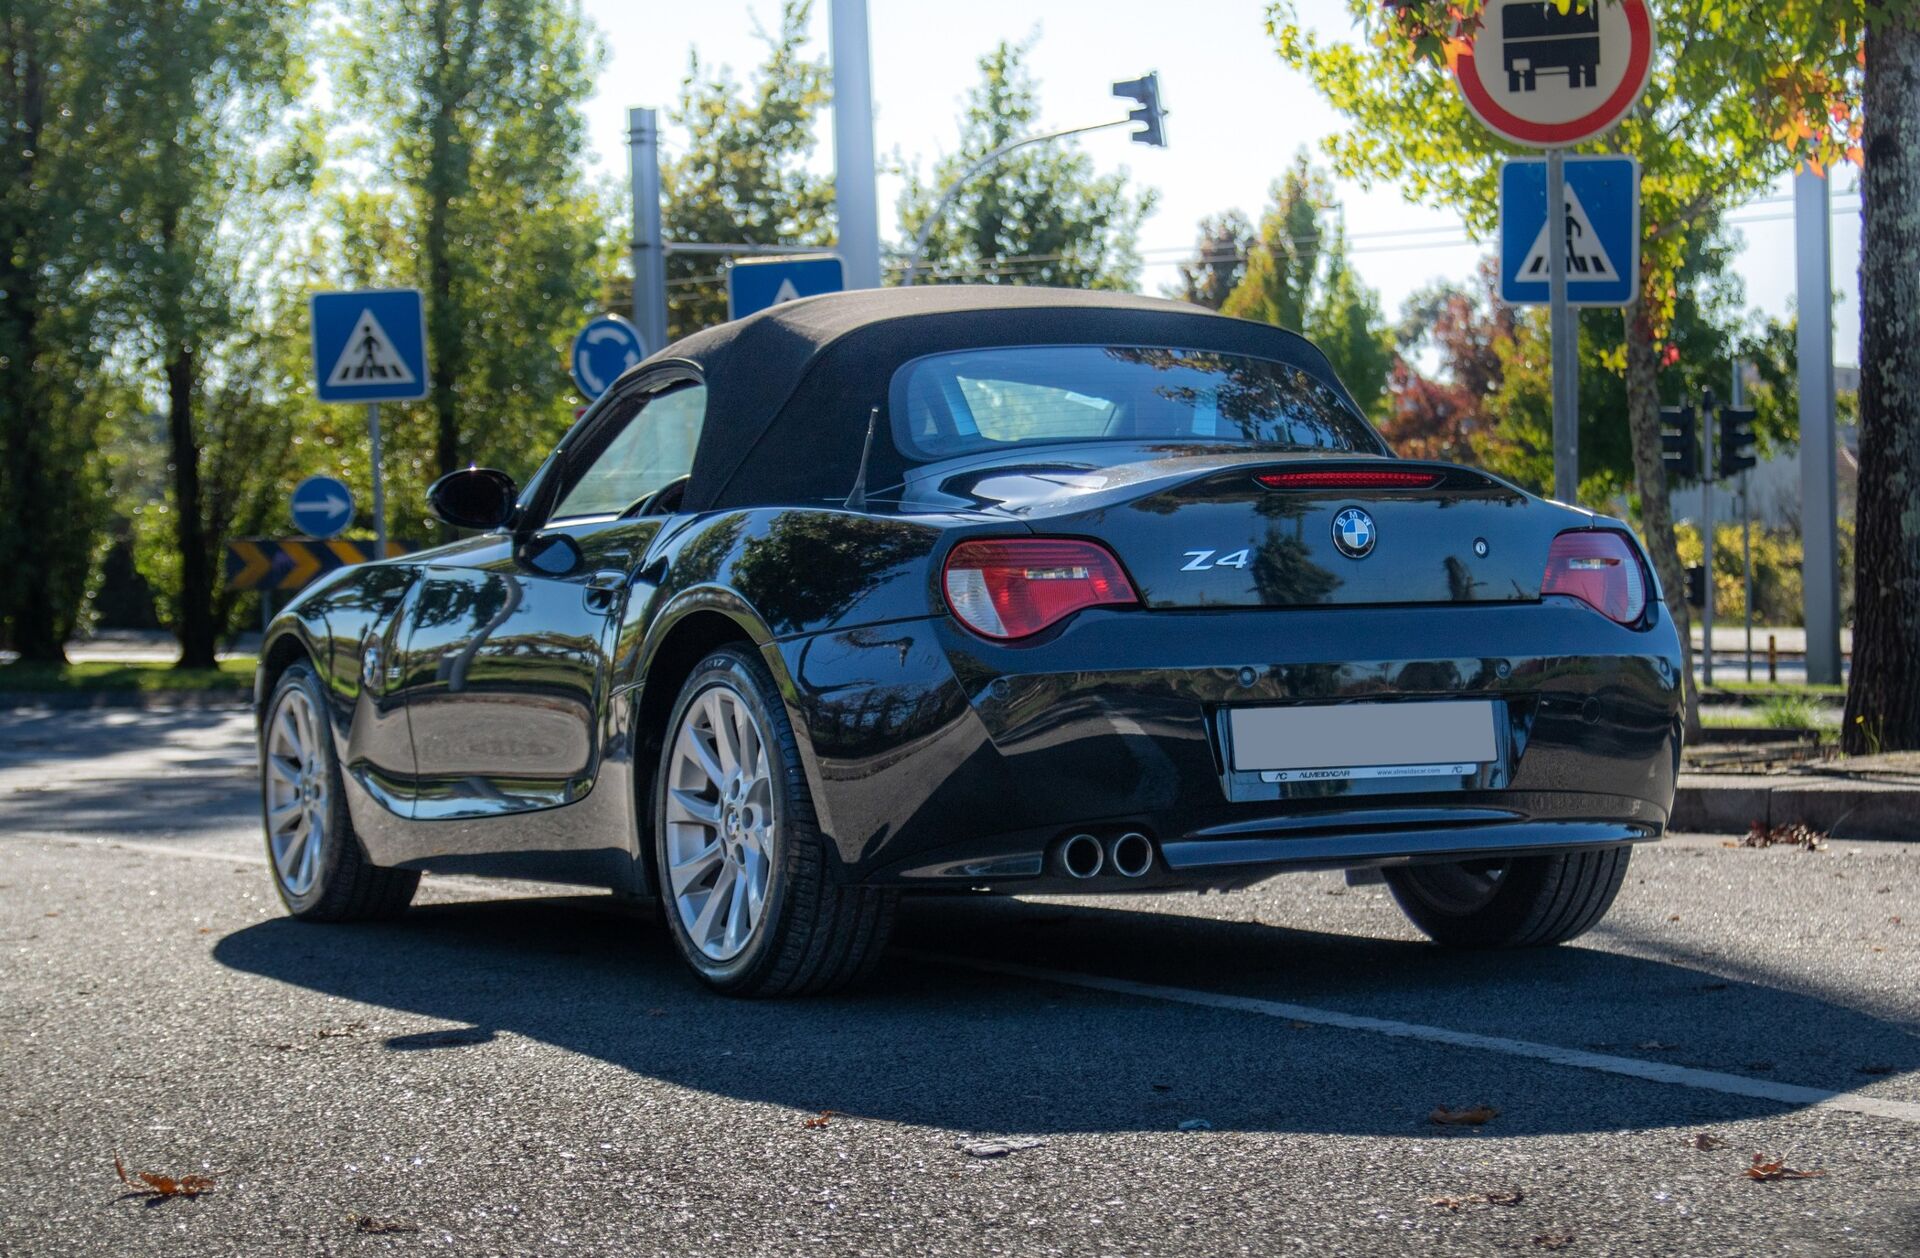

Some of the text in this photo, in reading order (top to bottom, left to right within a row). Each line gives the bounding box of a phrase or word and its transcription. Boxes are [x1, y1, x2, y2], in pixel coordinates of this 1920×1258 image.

[1336, 511, 1372, 527] BMW
[1180, 549, 1250, 572] Z4
[1299, 770, 1350, 779] ALMEIDACAR
[1376, 767, 1441, 776] www.almeidacar.com
